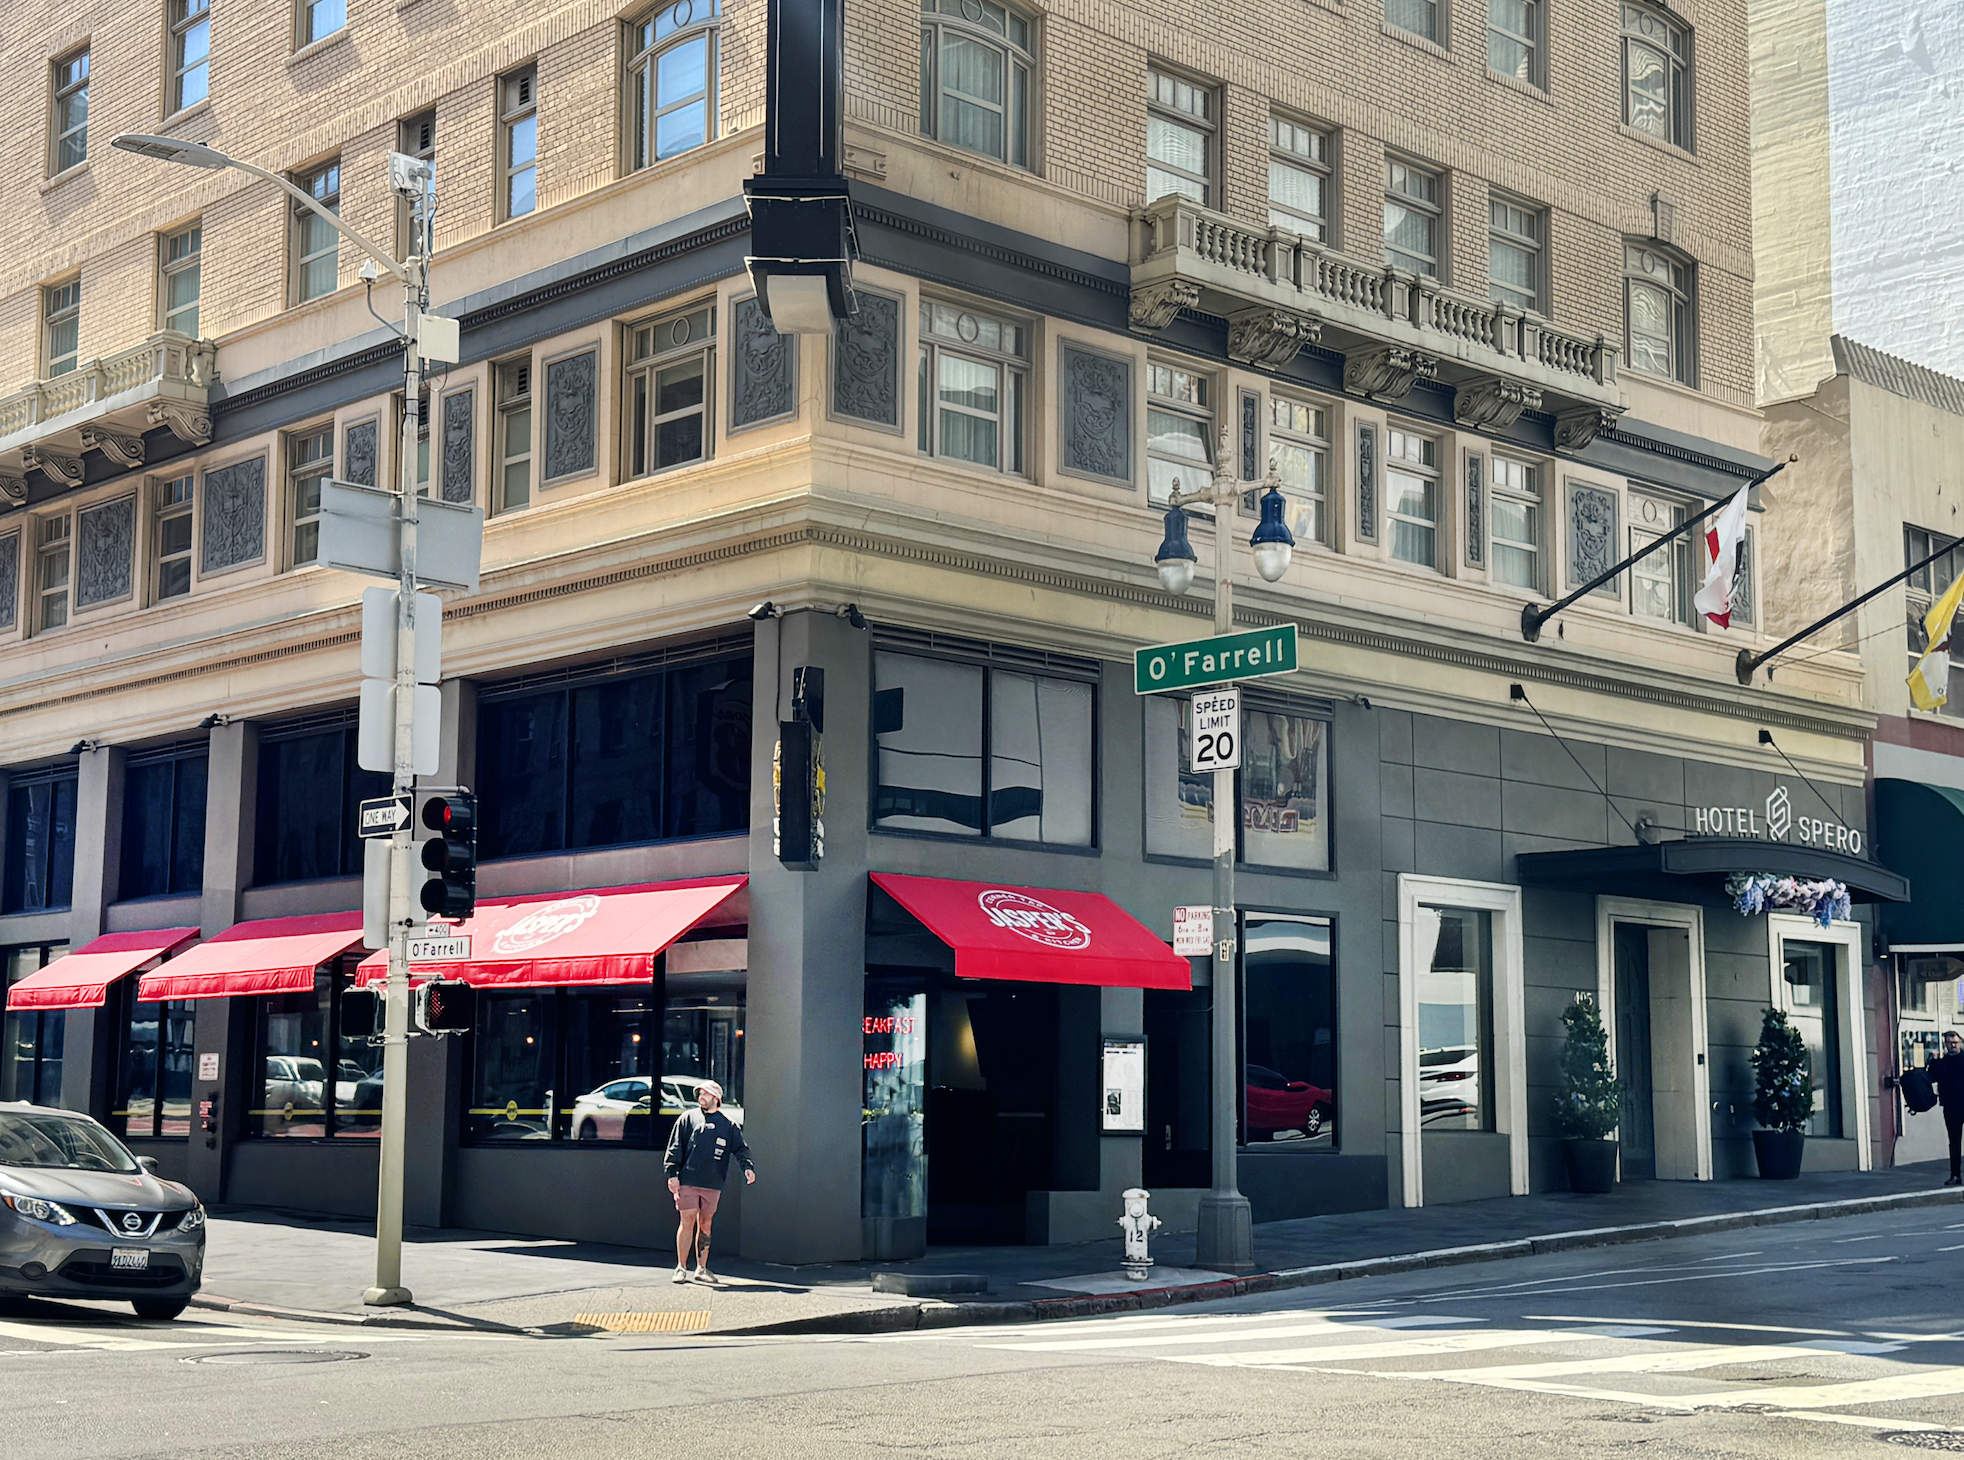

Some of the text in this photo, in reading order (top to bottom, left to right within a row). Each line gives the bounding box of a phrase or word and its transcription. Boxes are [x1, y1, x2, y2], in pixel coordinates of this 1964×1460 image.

[1149, 638, 1283, 680] O'Farrell
[1196, 698, 1236, 714] SPEED
[1200, 715, 1231, 730] LIMIT
[1197, 732, 1234, 763] 20
[365, 809, 397, 825] ONE WAY
[1695, 807, 1862, 854] HOTEL SPERO
[981, 905, 1092, 934] JASPER'S
[1175, 908, 1211, 922] NO PARKING
[412, 941, 463, 957] O'Farrell
[864, 1052, 903, 1070] HAPPY
[1130, 1230, 1143, 1243] 12
